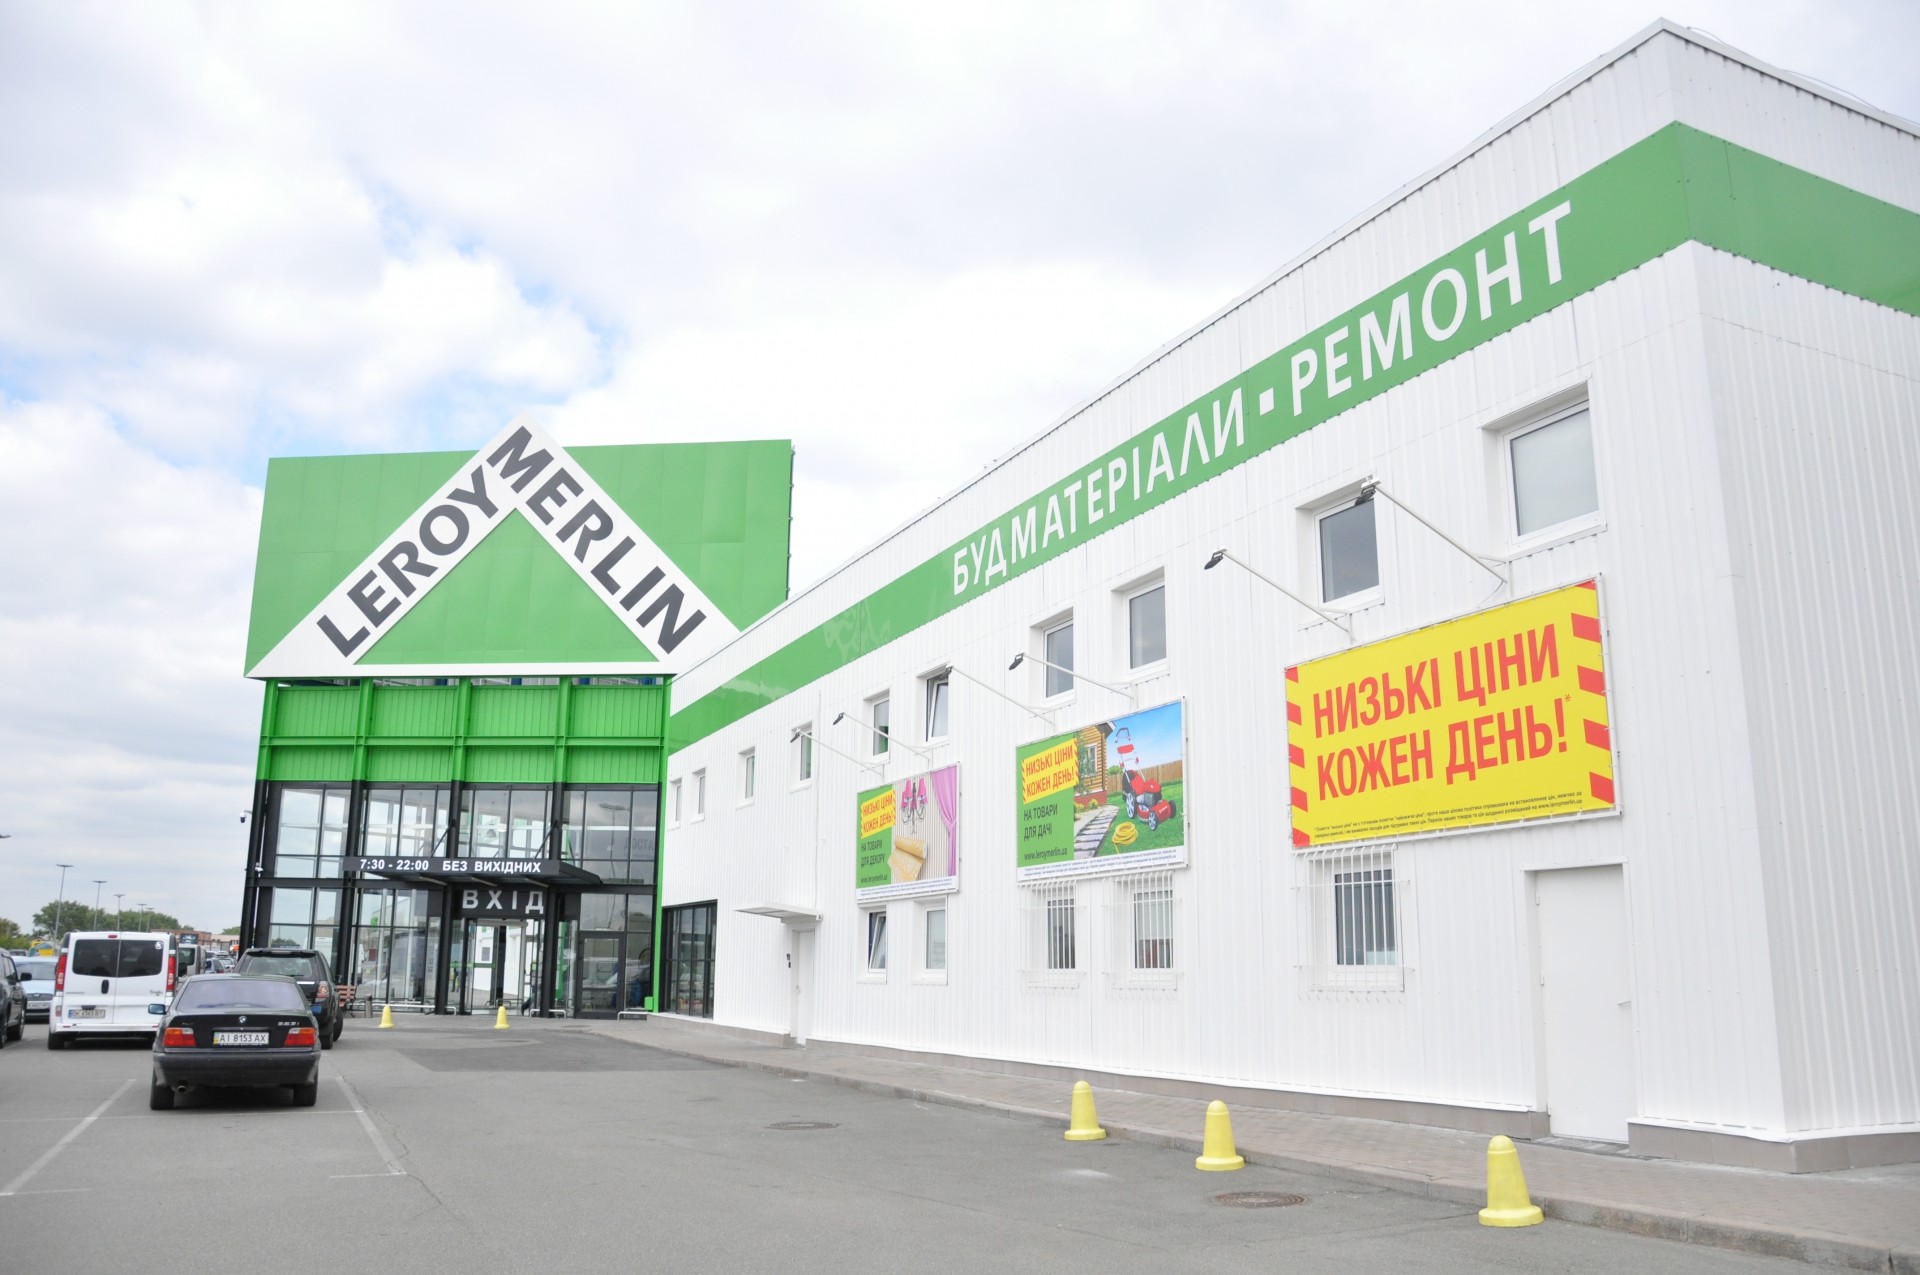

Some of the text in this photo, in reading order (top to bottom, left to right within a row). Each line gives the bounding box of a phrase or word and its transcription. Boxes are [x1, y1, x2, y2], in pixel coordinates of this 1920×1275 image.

[952, 200, 1571, 596] БУДМАТЕРІАЛИ РЕМОНТ
[316, 425, 707, 658] LEROY MERLIN
[1313, 623, 1560, 739] НИЗЬКІ ЦІНИ
[1026, 745, 1073, 776] НИЗЬКІ ЦІНИ
[1317, 729, 1434, 801] КОЖЕН
[1026, 766, 1075, 797] КОЖЕН ДЕНЬ!
[1023, 803, 1058, 821] НА ТОВАРИ
[1023, 822, 1053, 841] ДЛЯ ДАЧІ
[359, 859, 385, 870] 7:30
[396, 859, 429, 871] 22:00
[442, 860, 468, 872] БЕЗ
[474, 861, 542, 874] ВИХІДНИХ
[1024, 847, 1068, 861] www.leroymerlin.ua
[462, 889, 544, 915] ВХІД
[220, 1034, 266, 1042] AI 8153 AX
